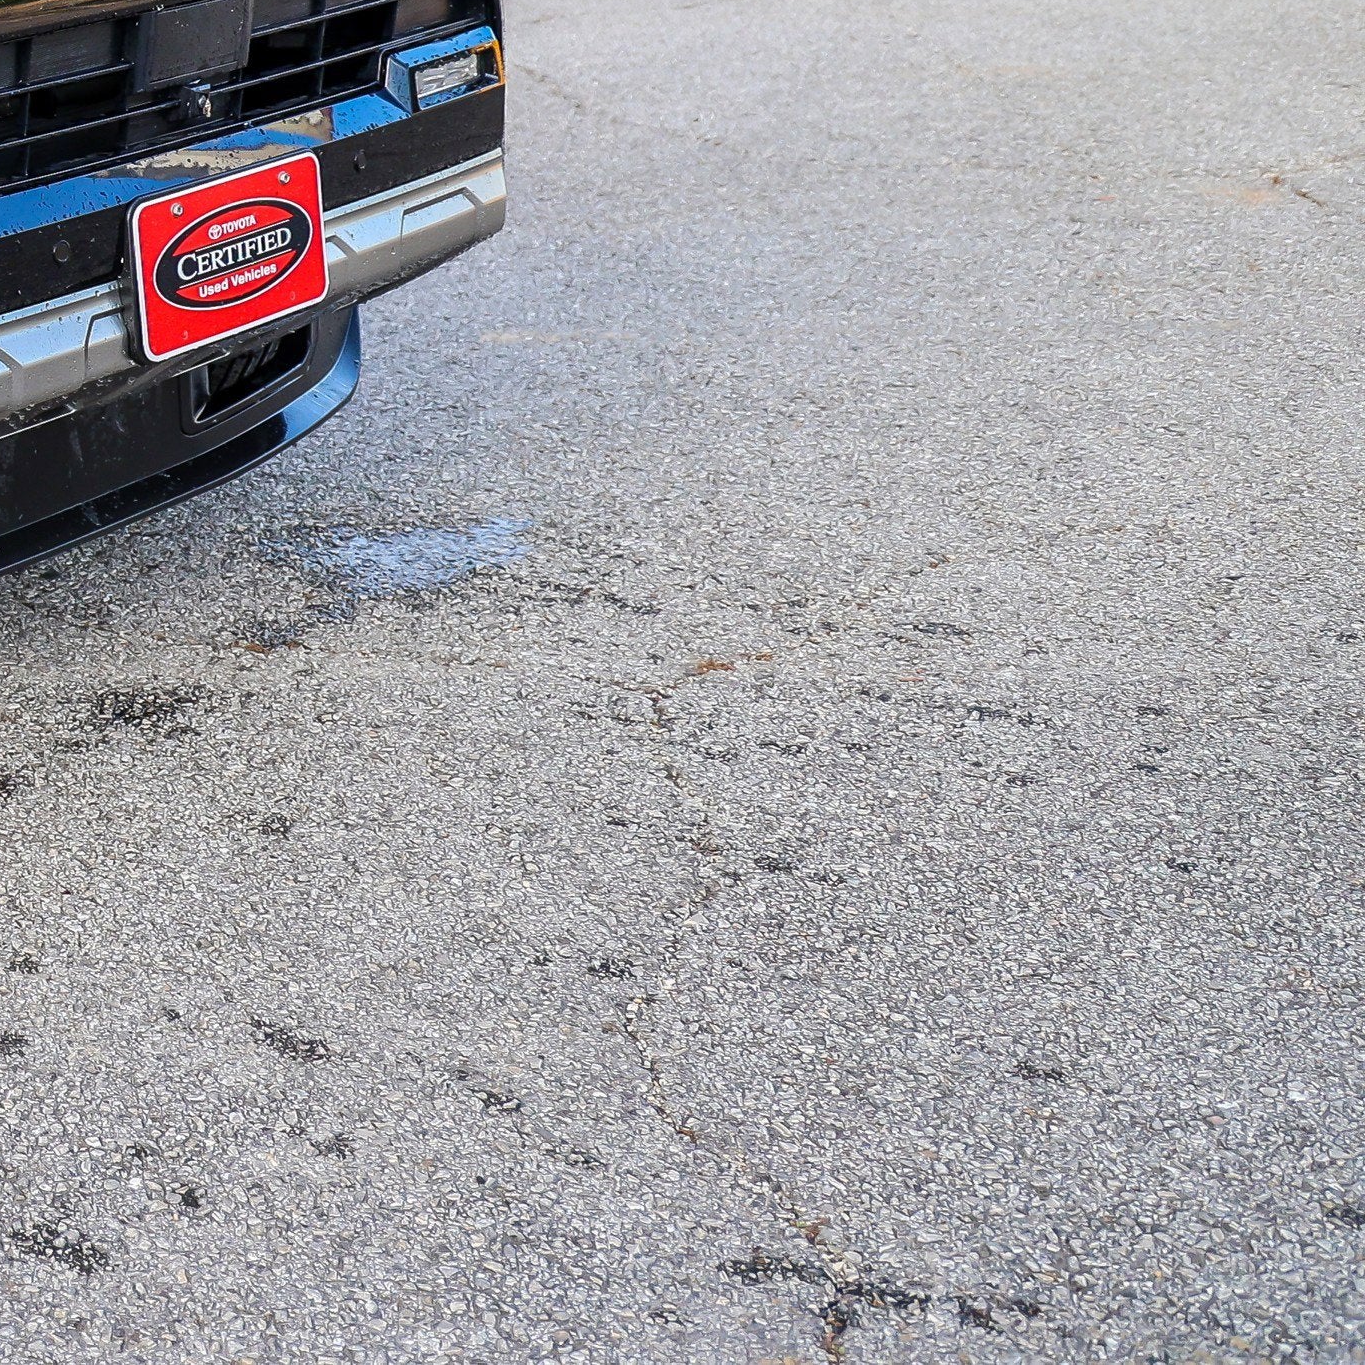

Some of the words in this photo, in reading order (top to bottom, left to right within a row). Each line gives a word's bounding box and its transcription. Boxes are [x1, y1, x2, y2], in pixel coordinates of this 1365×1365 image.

[221, 214, 257, 235] TOYOTA
[177, 227, 292, 281] CERTIFIED
[199, 277, 229, 298] Used
[231, 263, 277, 287] Vehicles
